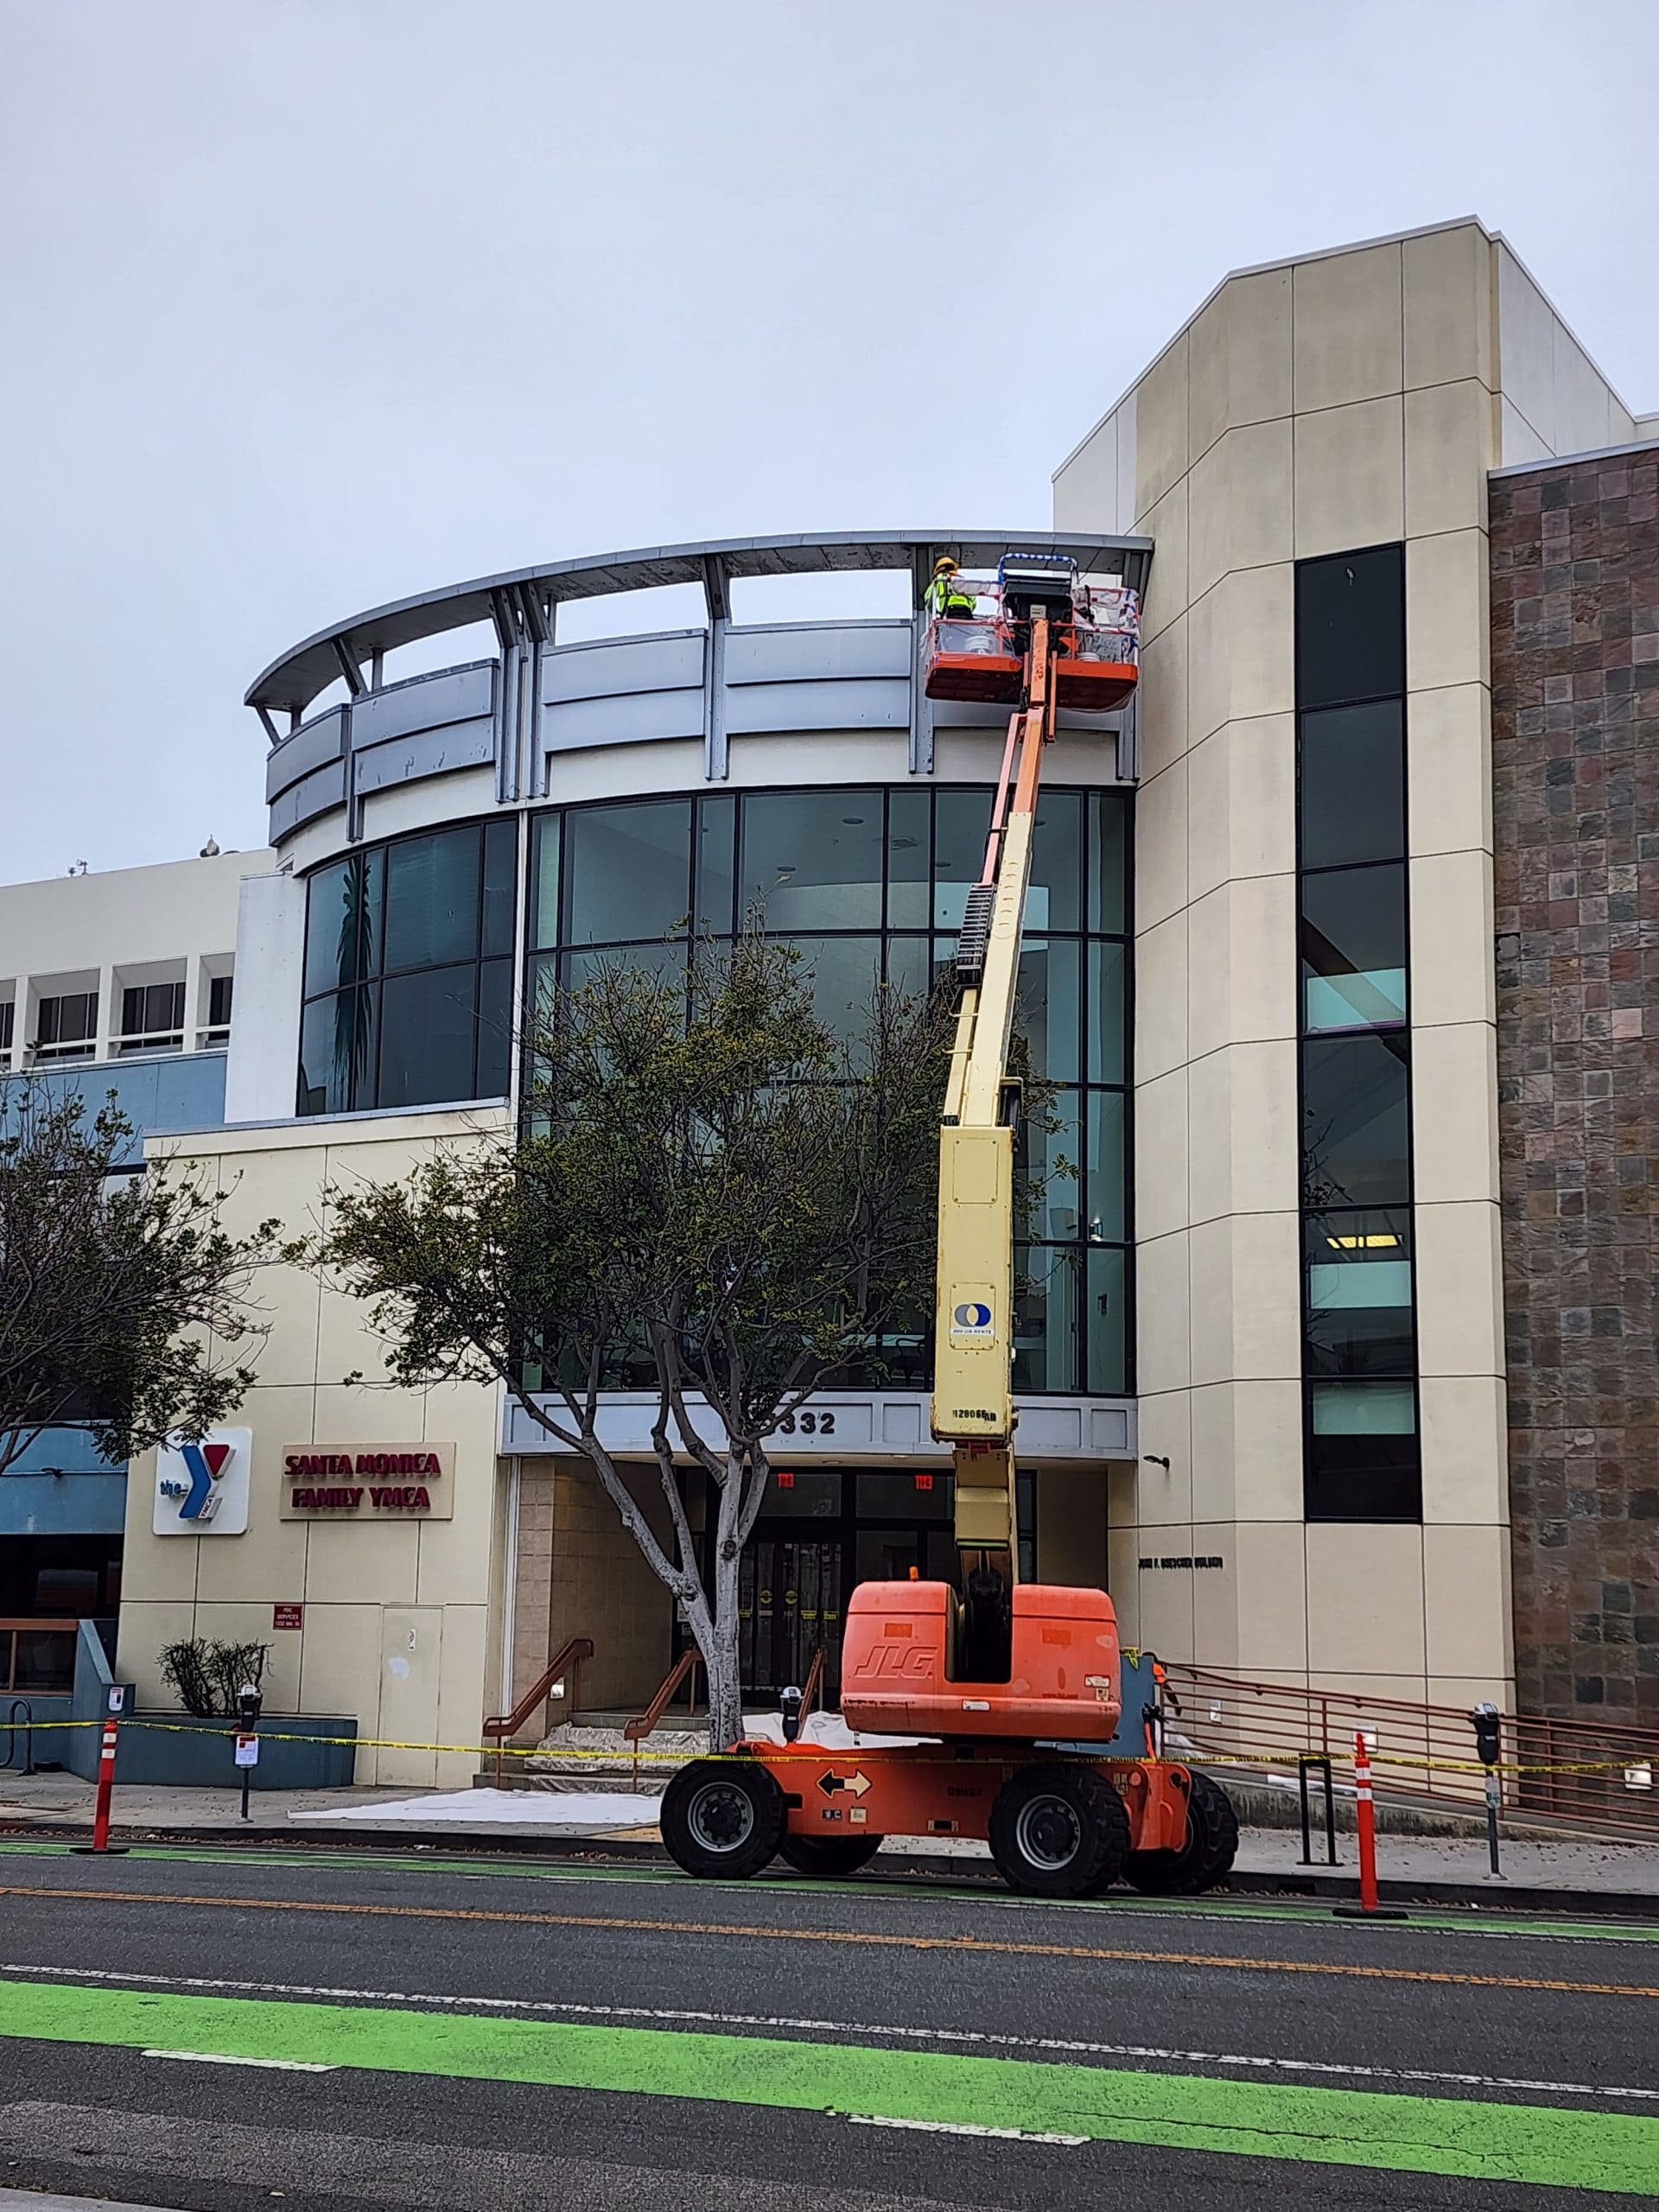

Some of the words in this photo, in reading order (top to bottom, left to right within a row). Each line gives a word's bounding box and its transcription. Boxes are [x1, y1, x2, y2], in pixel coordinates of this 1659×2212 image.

[284, 1454, 353, 1475] SANTA
[355, 1453, 442, 1474] MONICA
[160, 1478, 181, 1496] the
[291, 1486, 364, 1508] FAMILY
[369, 1486, 431, 1508] YMCA
[200, 1498, 213, 1517] YMCA
[854, 1645, 938, 1679] JLG
